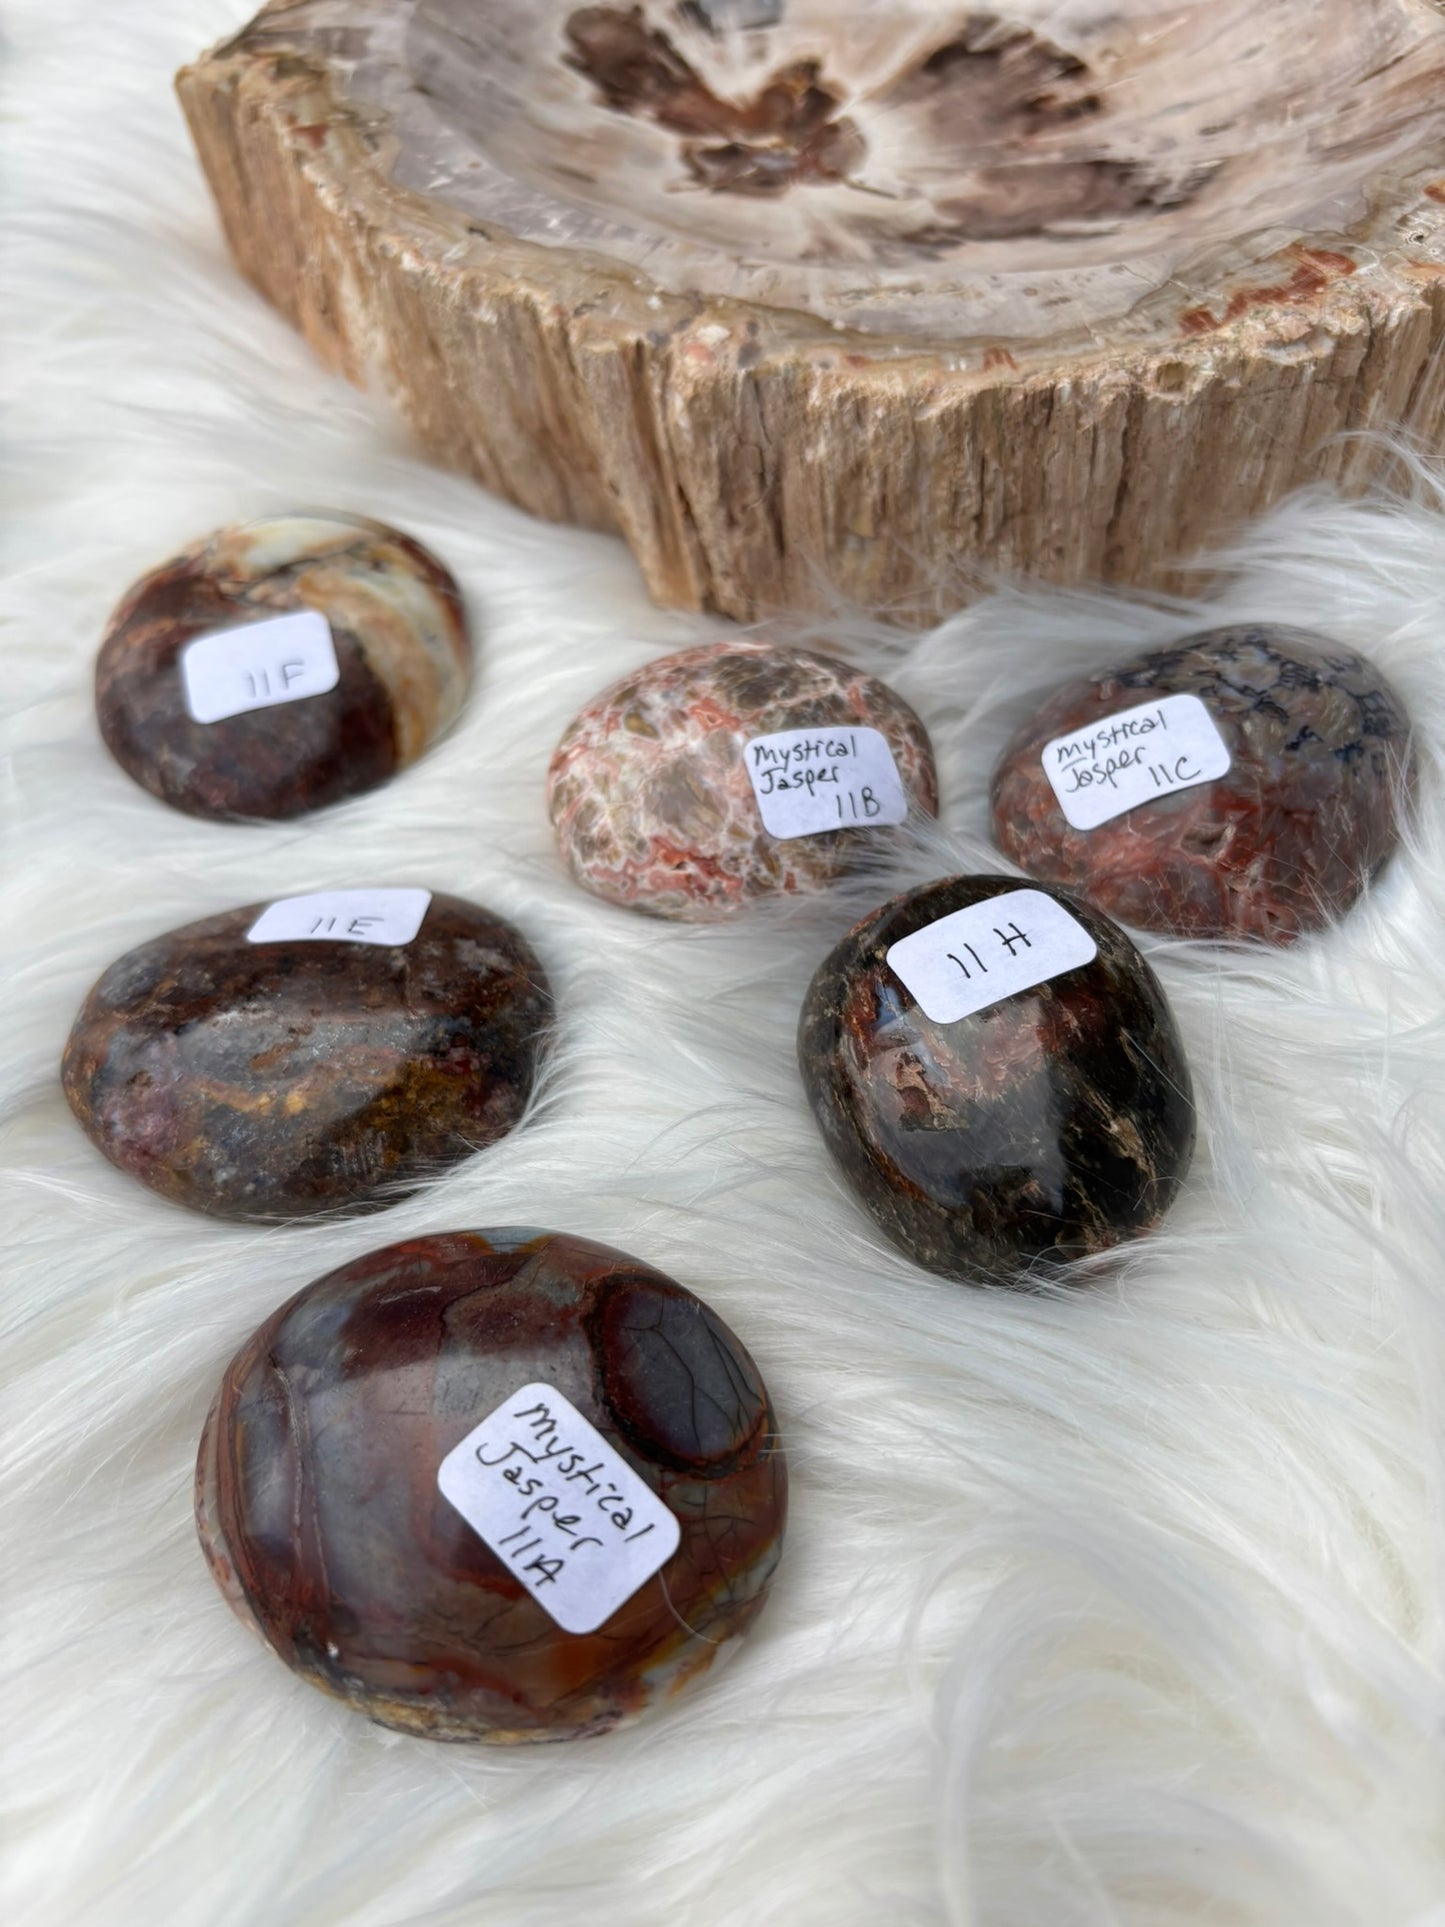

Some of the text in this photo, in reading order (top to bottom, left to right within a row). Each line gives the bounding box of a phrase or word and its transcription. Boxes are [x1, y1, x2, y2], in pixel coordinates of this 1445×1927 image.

[759, 766, 839, 797] Jasper
[1148, 755, 1201, 787] 11C
[836, 786, 881, 818] 11B
[475, 1441, 604, 1551] Jasper
[498, 1525, 565, 1587] 11A
